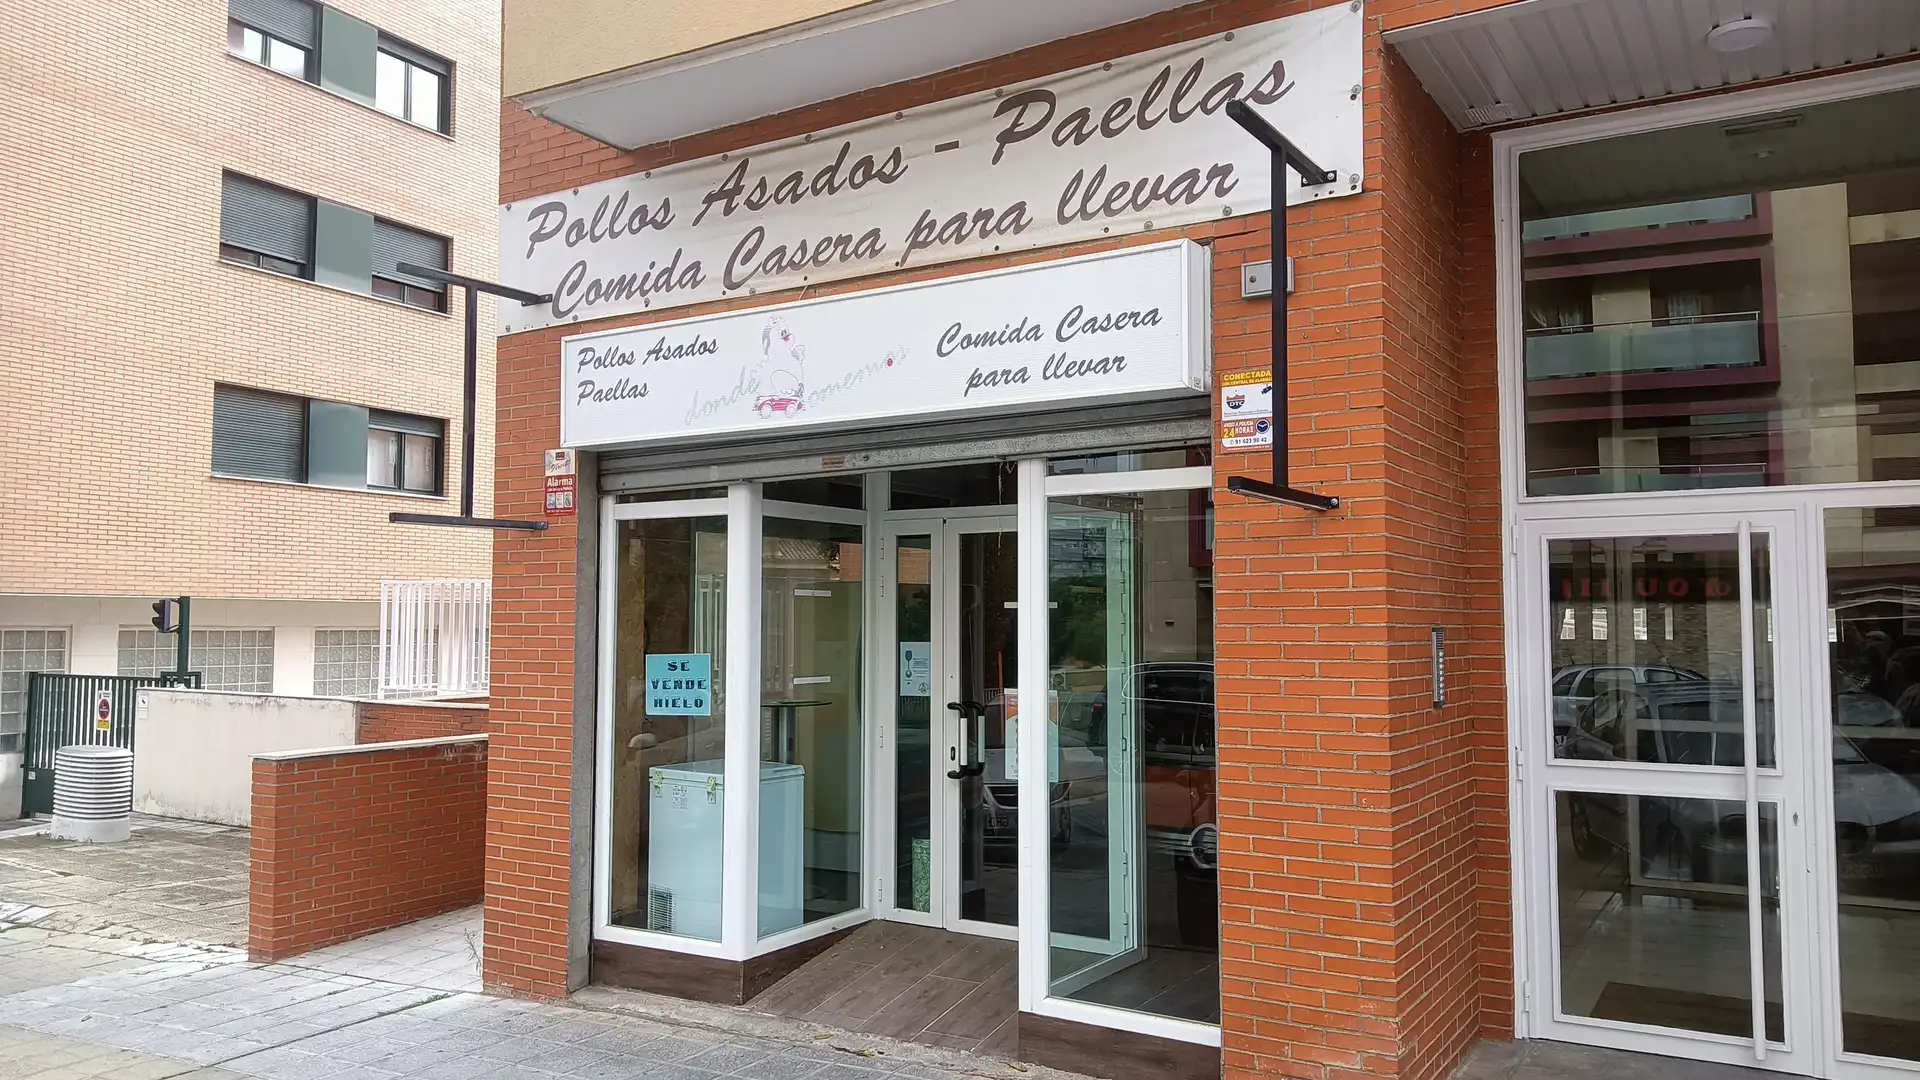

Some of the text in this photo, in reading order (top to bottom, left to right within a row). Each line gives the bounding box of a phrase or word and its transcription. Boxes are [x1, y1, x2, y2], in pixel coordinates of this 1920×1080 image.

[526, 189, 676, 258] Pollos
[692, 141, 909, 227] Asados
[992, 57, 1295, 165] Paellas
[551, 163, 1240, 320] Comida Casera para llevar
[936, 304, 1162, 358] Comida Casera
[577, 334, 719, 373] Pollos Asados
[963, 351, 1128, 397] para llevar
[1224, 370, 1272, 381] CONECTADA
[577, 377, 649, 406] Paellas
[1223, 425, 1254, 438] 24 HORAS
[547, 477, 573, 487] Alarma
[667, 660, 690, 672] SE
[650, 677, 707, 690] VENDE
[654, 696, 704, 708] HIELO
